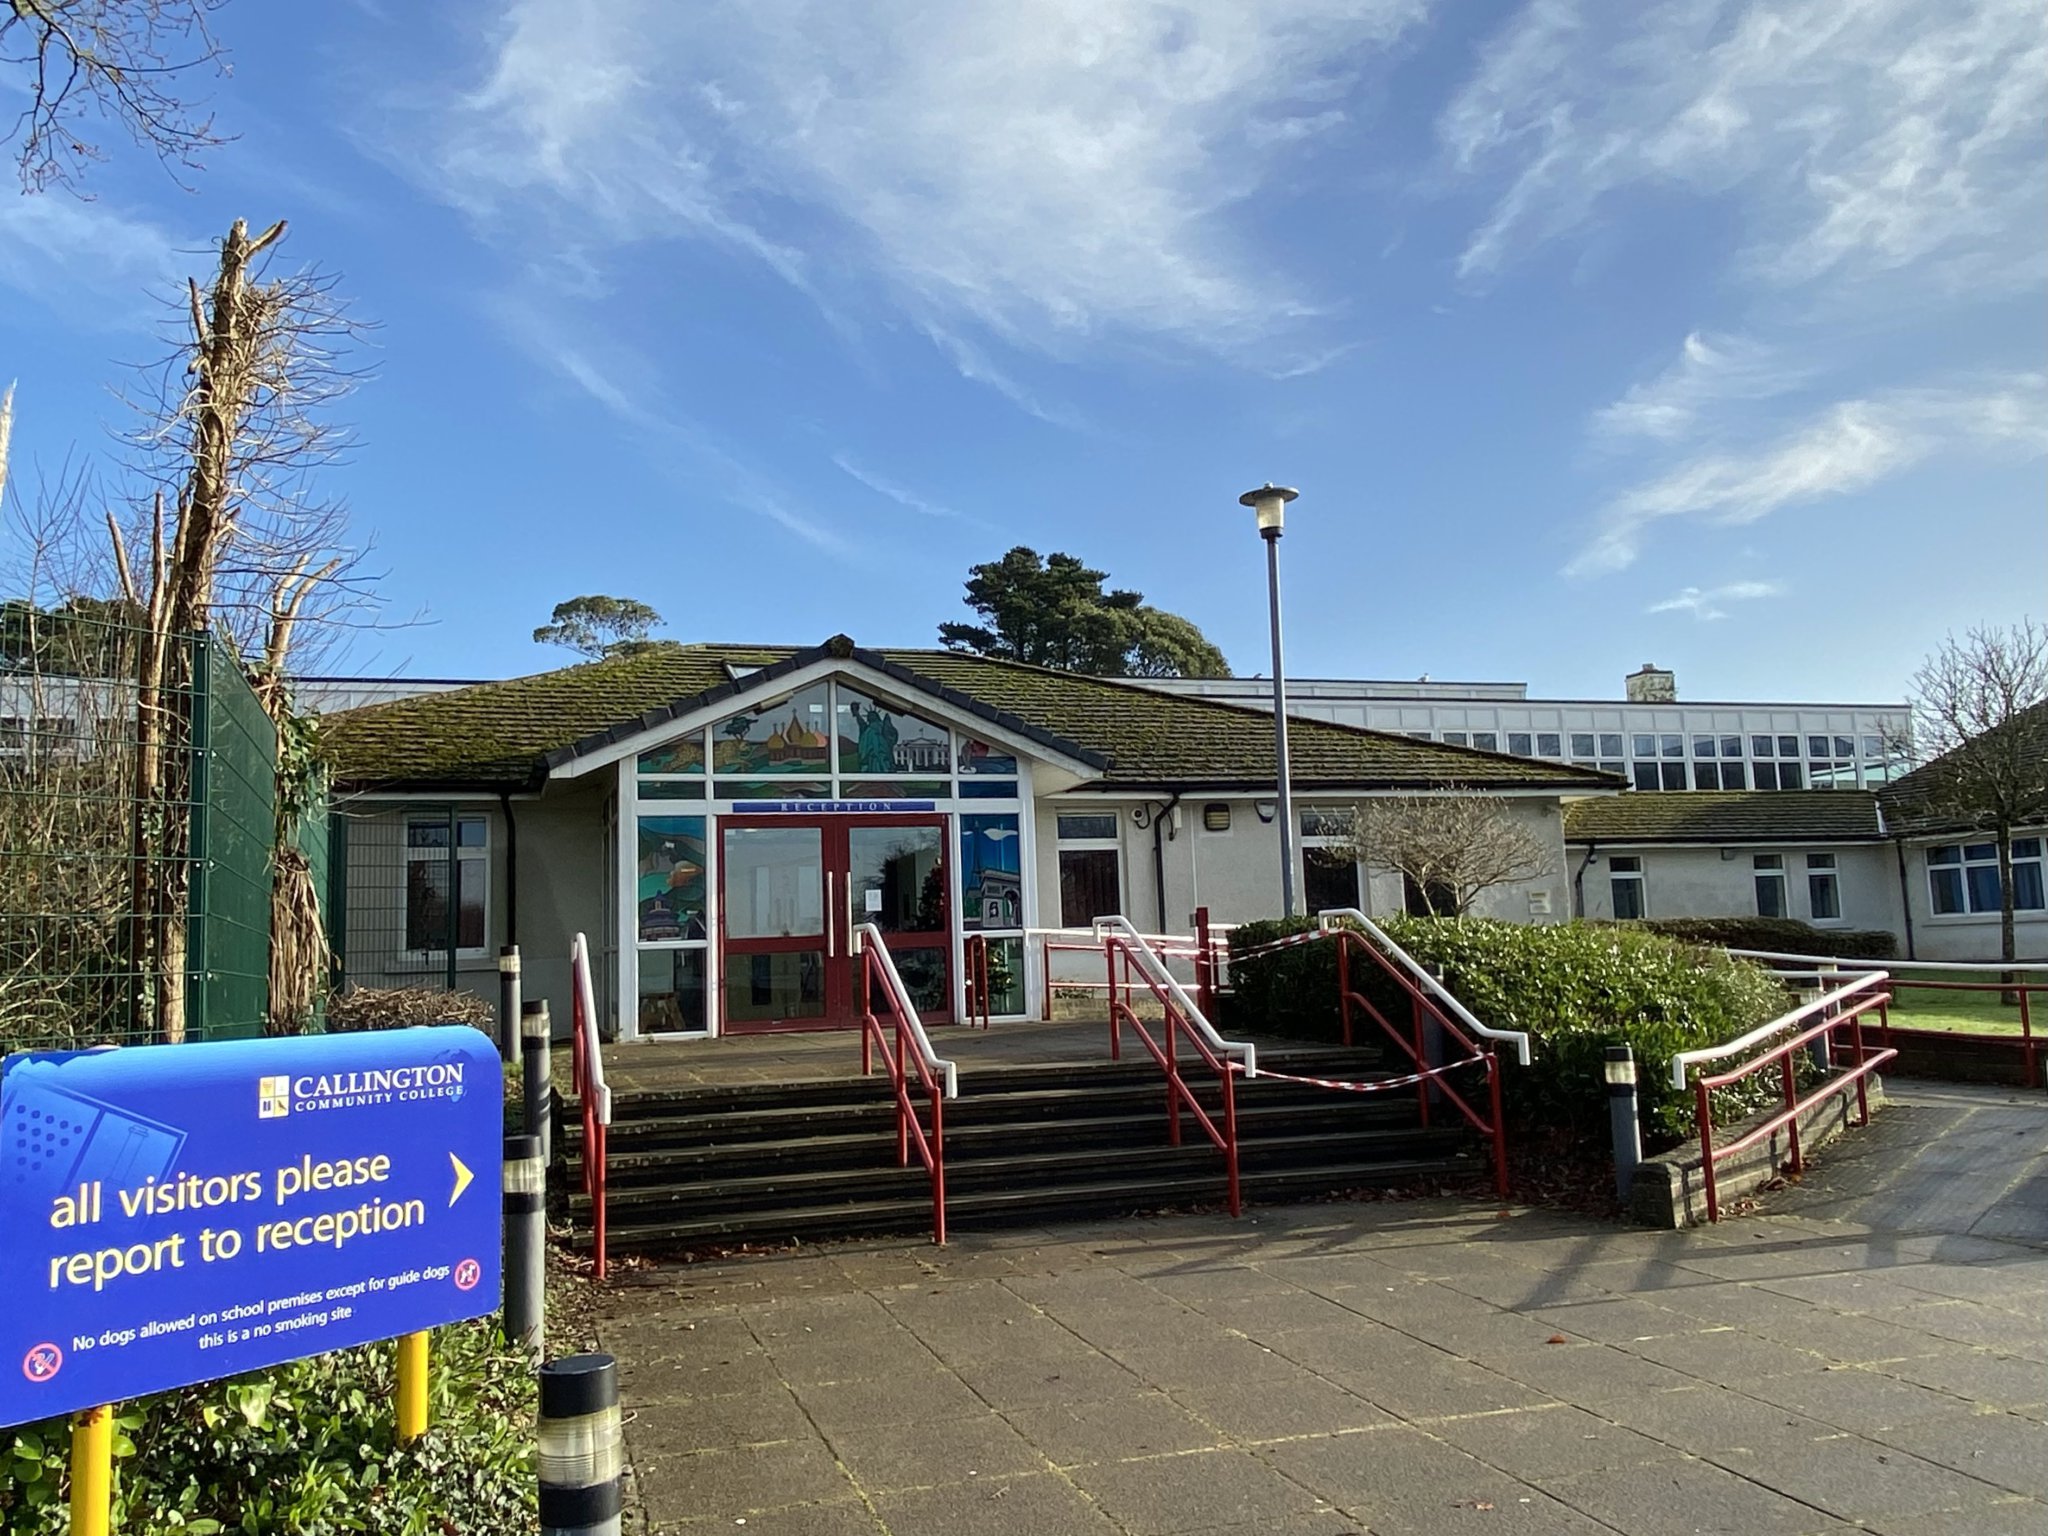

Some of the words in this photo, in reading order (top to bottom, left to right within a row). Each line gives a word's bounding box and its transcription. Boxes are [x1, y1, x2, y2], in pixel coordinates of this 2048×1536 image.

[780, 803, 892, 811] RECEPTION
[294, 1063, 464, 1098] CALLINGTON
[295, 1093, 393, 1112] COMMUNITY
[400, 1085, 463, 1101] COLLEGE
[50, 1181, 101, 1228] all
[119, 1172, 261, 1218] visitors
[277, 1154, 391, 1205] please
[49, 1234, 185, 1291] report
[199, 1228, 241, 1262] to
[257, 1198, 425, 1252] reception
[73, 1336, 95, 1351] No
[99, 1329, 136, 1346] dogs
[140, 1314, 195, 1338] allowed
[199, 1312, 217, 1326] on
[221, 1300, 264, 1322] school
[268, 1291, 323, 1315] premises
[325, 1281, 366, 1299] except
[368, 1277, 386, 1291] for
[388, 1270, 420, 1290] guide
[422, 1265, 450, 1282] dogs
[198, 1332, 224, 1349] this
[227, 1329, 238, 1343] is
[241, 1329, 250, 1340] a
[254, 1324, 272, 1338] no
[275, 1311, 328, 1334] smoking
[331, 1306, 352, 1321] site
